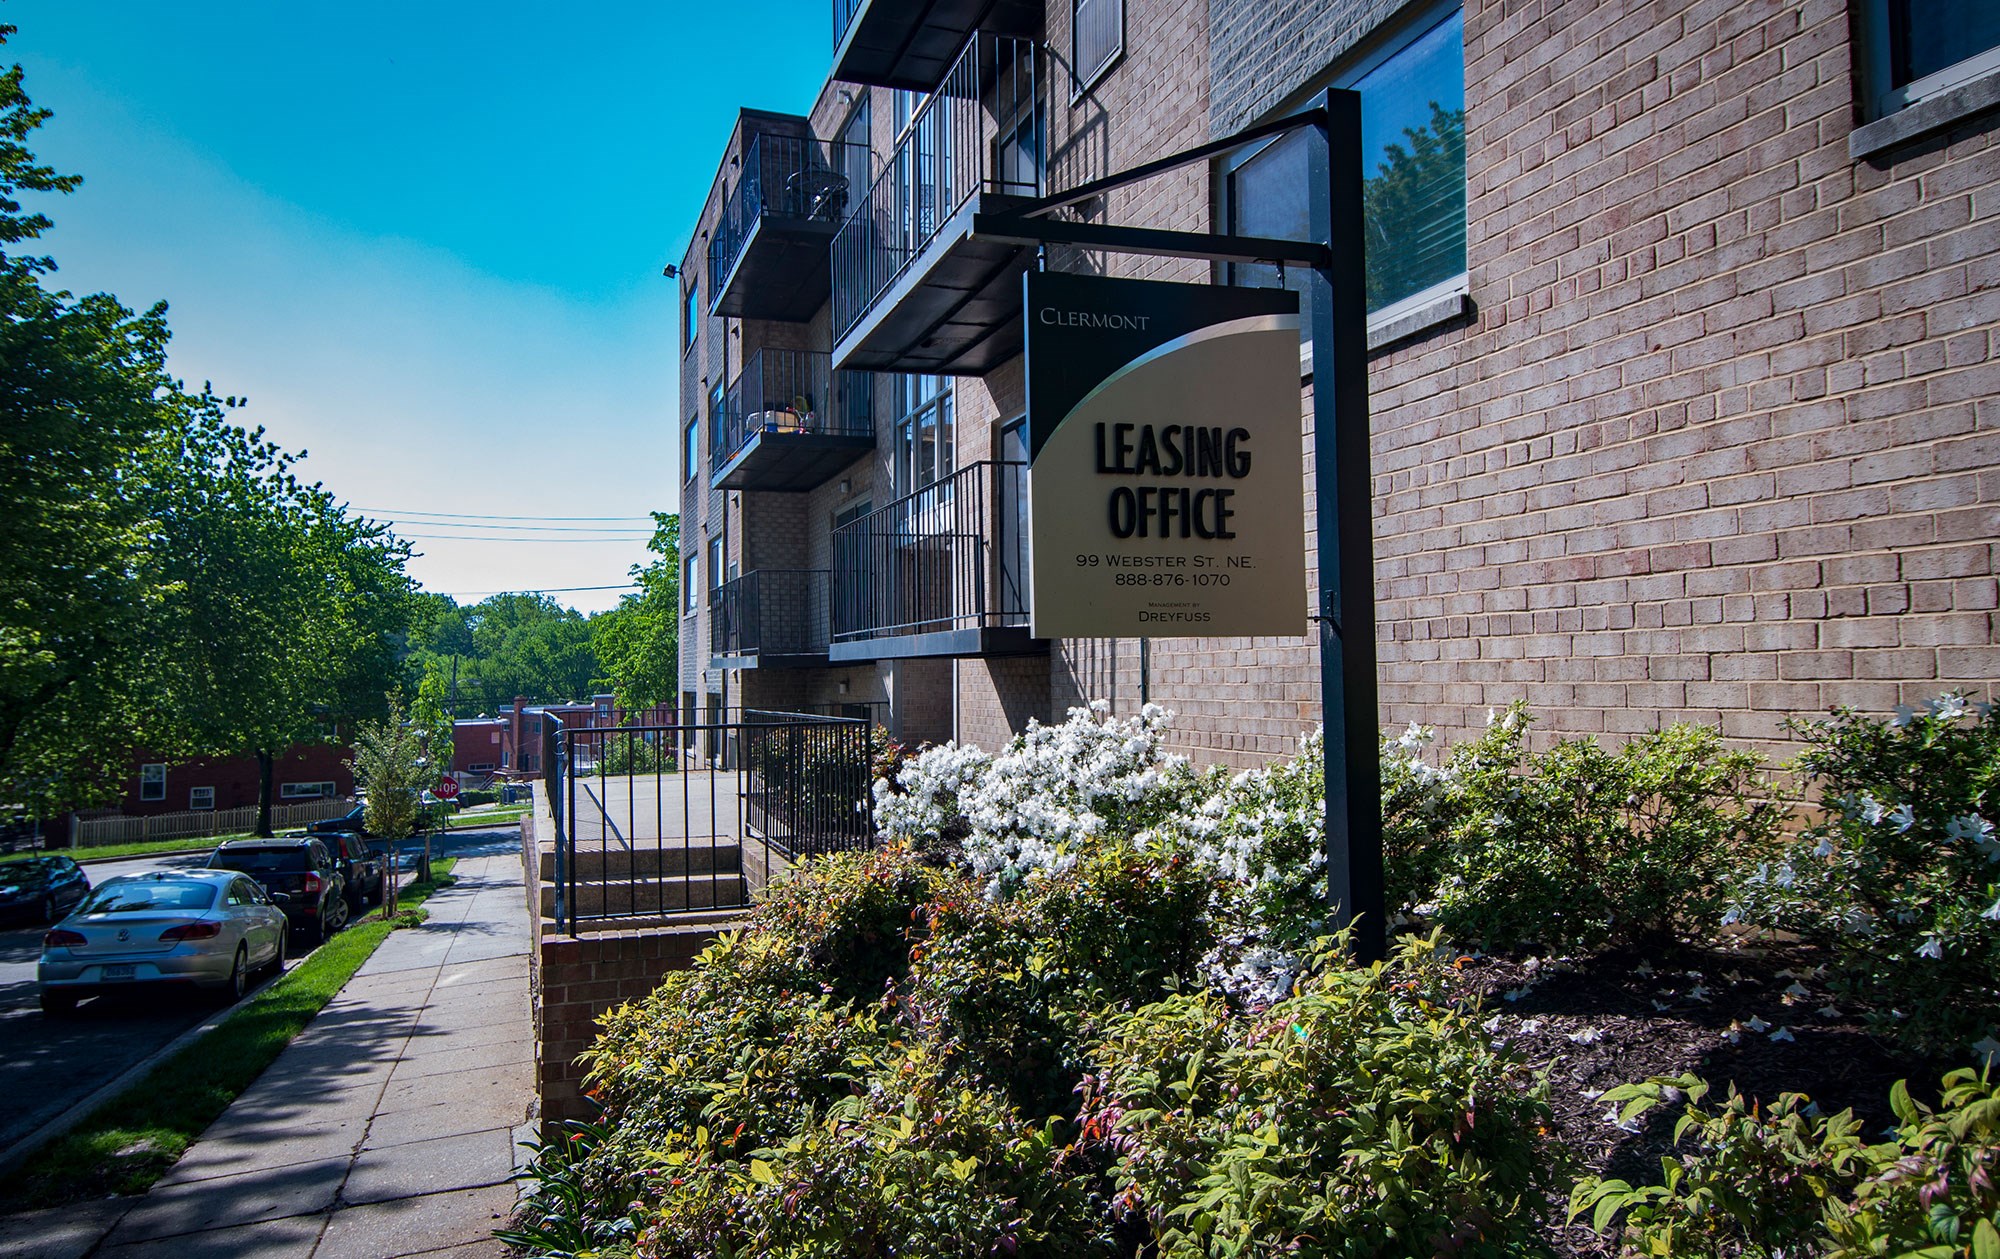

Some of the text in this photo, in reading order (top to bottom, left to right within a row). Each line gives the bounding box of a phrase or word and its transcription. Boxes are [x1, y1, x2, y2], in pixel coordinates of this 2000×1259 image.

[1040, 307, 1150, 330] CLERMONT
[1095, 422, 1251, 479] LEASING
[1109, 486, 1236, 539] OFFICE
[1076, 554, 1256, 569] 99 WEBSTER ST. NE.
[1115, 573, 1231, 587] 888-876-1070
[1139, 611, 1211, 622] DREYFUSS
